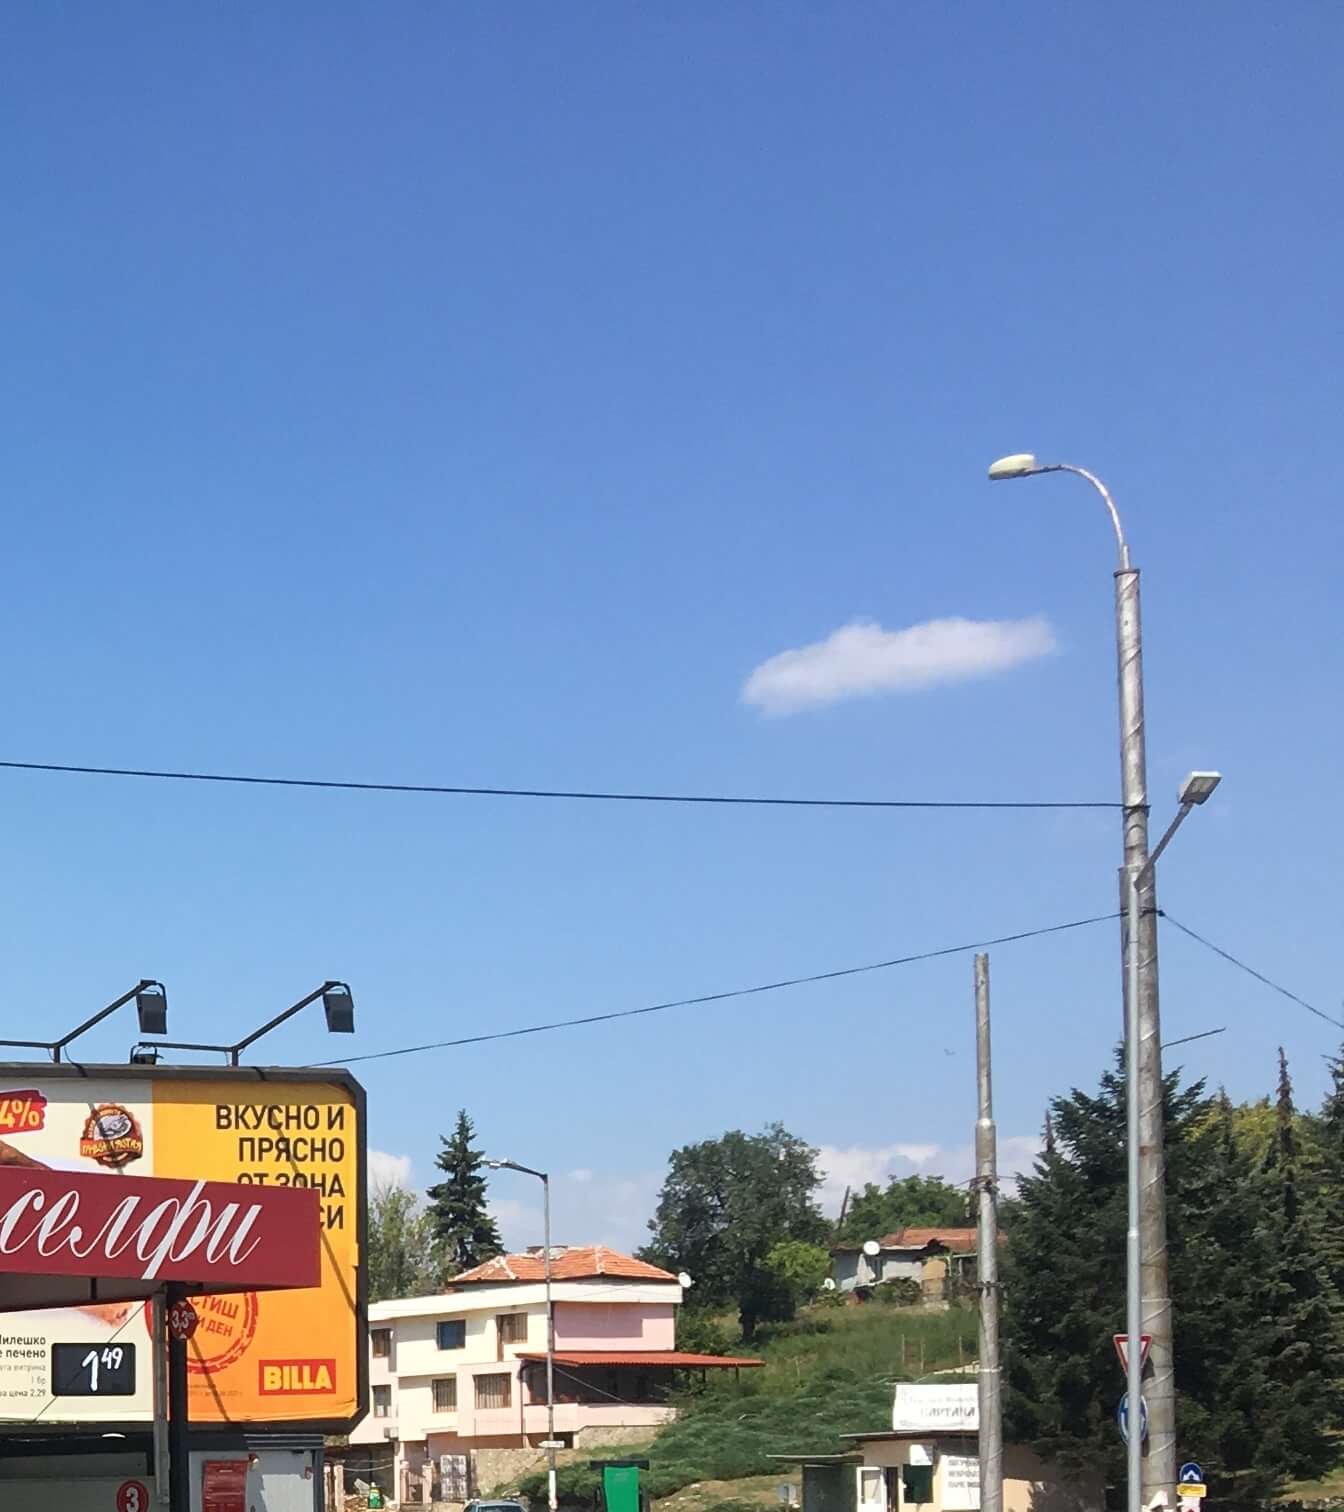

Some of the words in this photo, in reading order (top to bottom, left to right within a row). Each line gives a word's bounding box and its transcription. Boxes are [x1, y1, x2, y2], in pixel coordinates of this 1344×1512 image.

[216, 1104, 320, 1130] ВКУСНО
[327, 1105, 345, 1131] И
[238, 1137, 345, 1163] ПРЯСНО
[0, 1179, 262, 1280] селфи
[191, 1296, 239, 1320] СТИШ
[205, 1319, 233, 1337] ДЕН
[6, 1348, 47, 1358] печено
[263, 1365, 333, 1390] BILLA
